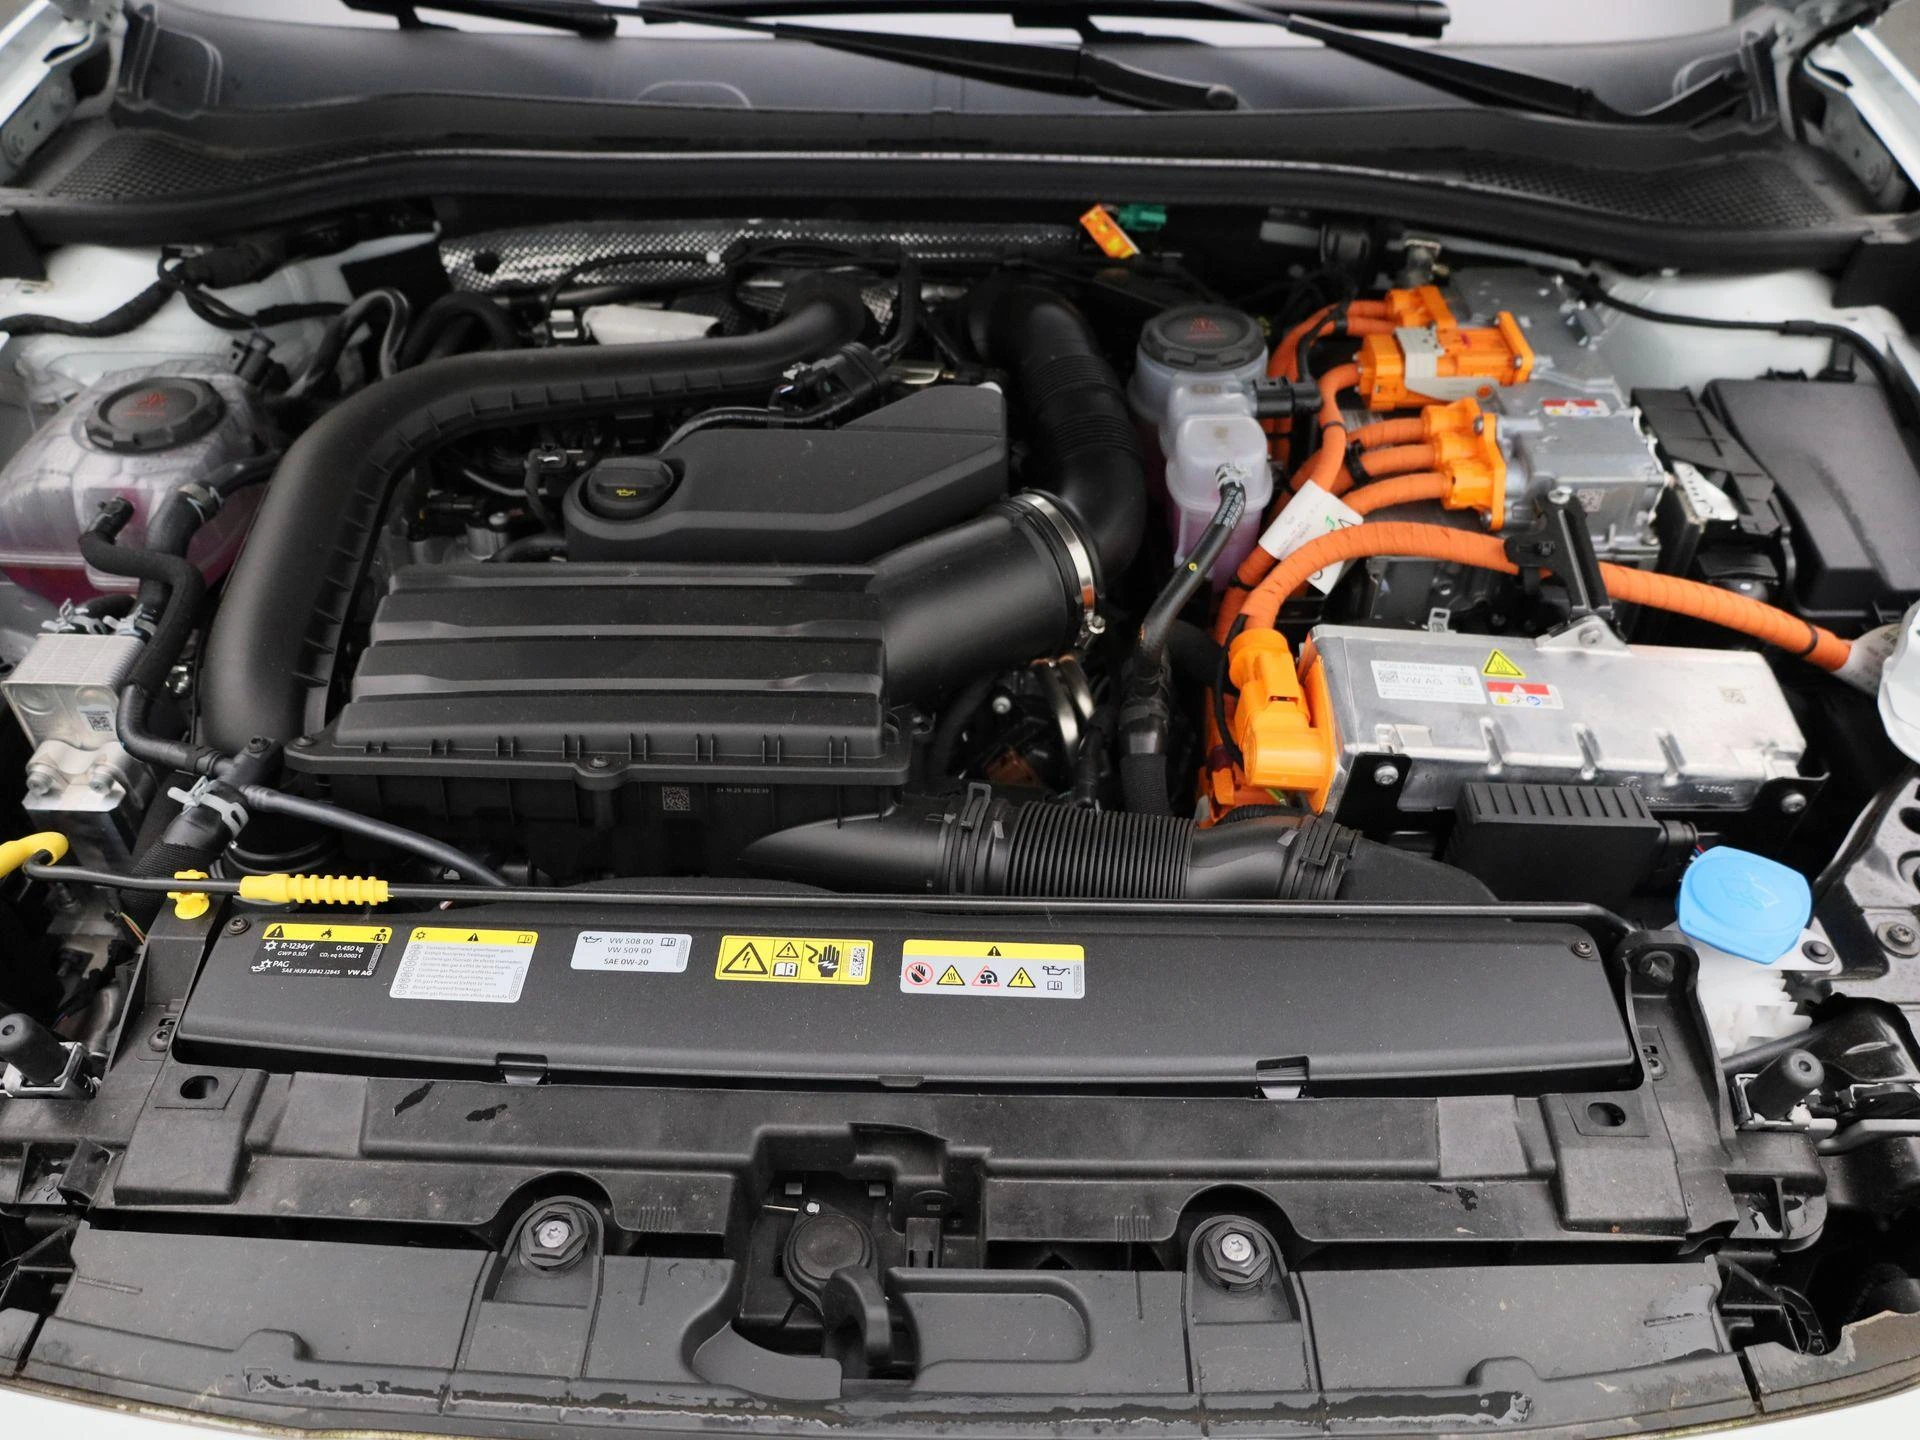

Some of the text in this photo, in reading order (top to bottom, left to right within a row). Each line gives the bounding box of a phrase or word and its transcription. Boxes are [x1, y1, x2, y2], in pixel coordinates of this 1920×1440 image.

[609, 937, 624, 945] VW
[280, 942, 315, 951] R-1234yf
[355, 945, 365, 953] kg
[272, 960, 290, 968] PAG
[620, 958, 649, 966] 0W-20
